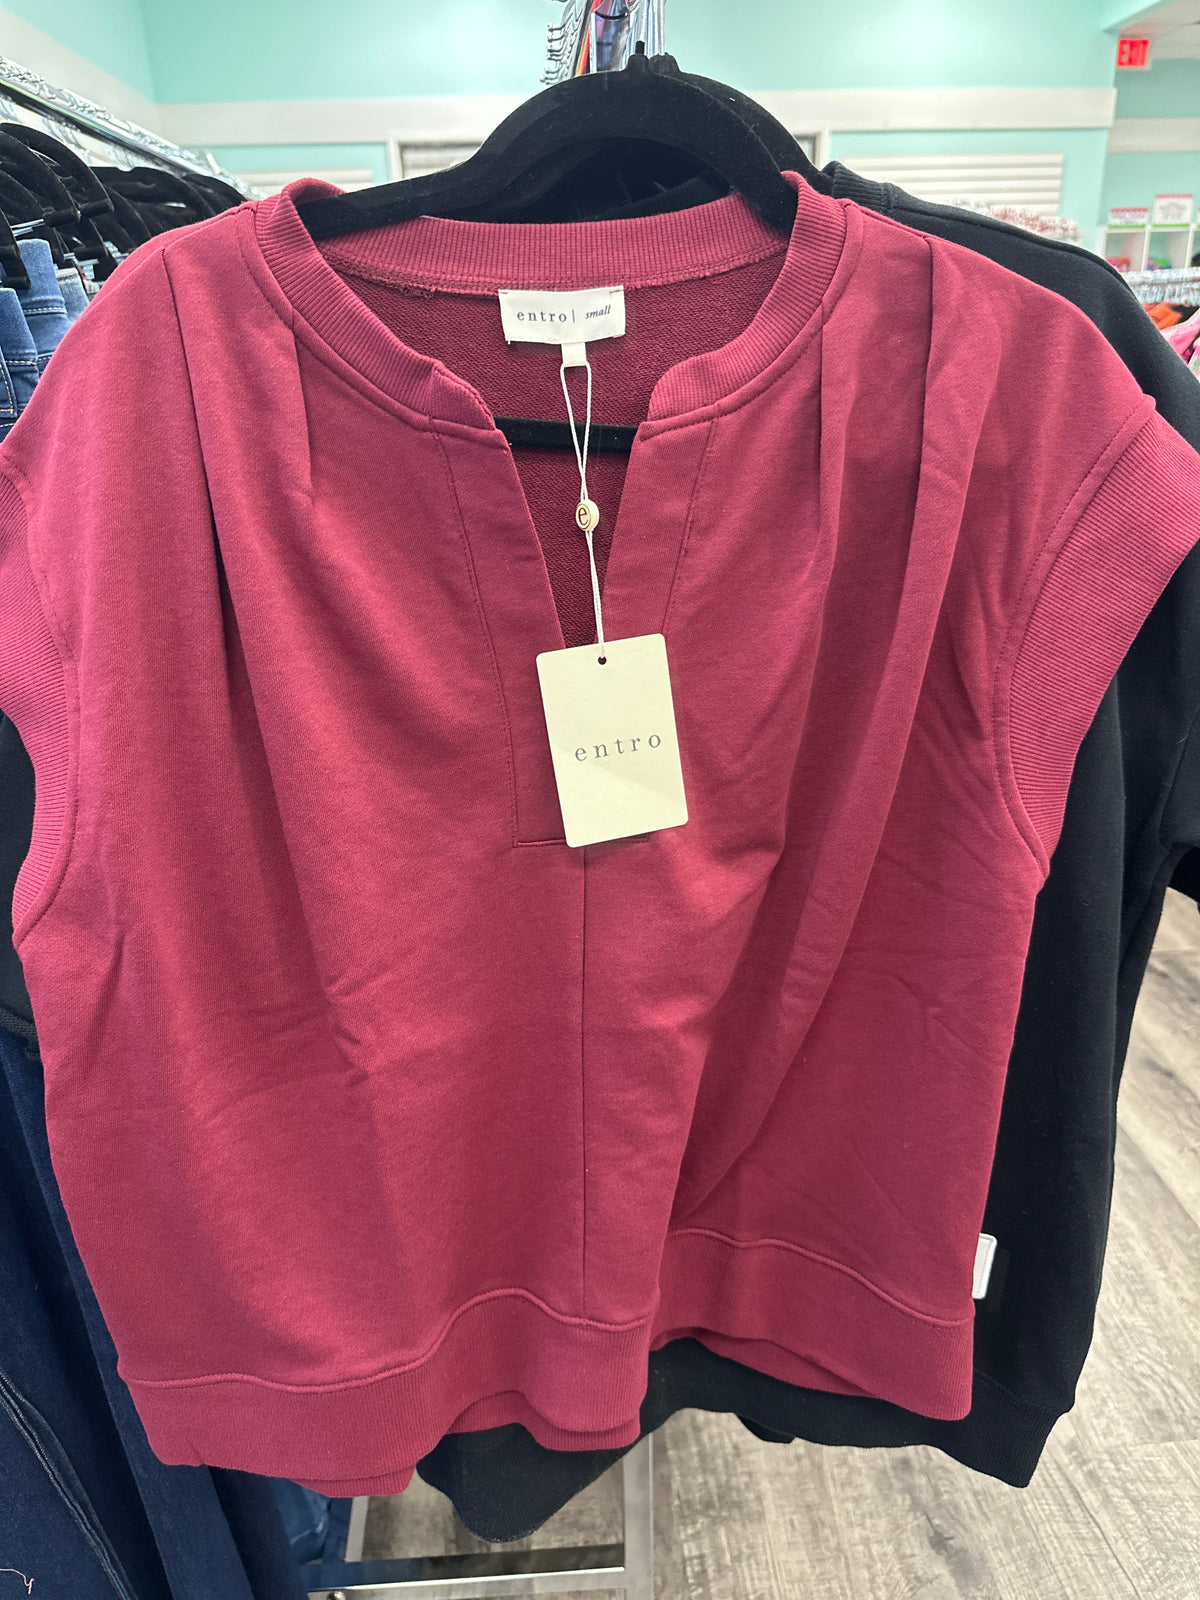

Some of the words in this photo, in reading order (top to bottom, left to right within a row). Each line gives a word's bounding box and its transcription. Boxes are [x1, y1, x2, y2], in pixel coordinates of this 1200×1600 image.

[1117, 39, 1149, 67] EXIT
[585, 305, 611, 320] small
[578, 507, 589, 526] e
[575, 733, 661, 762] entro
